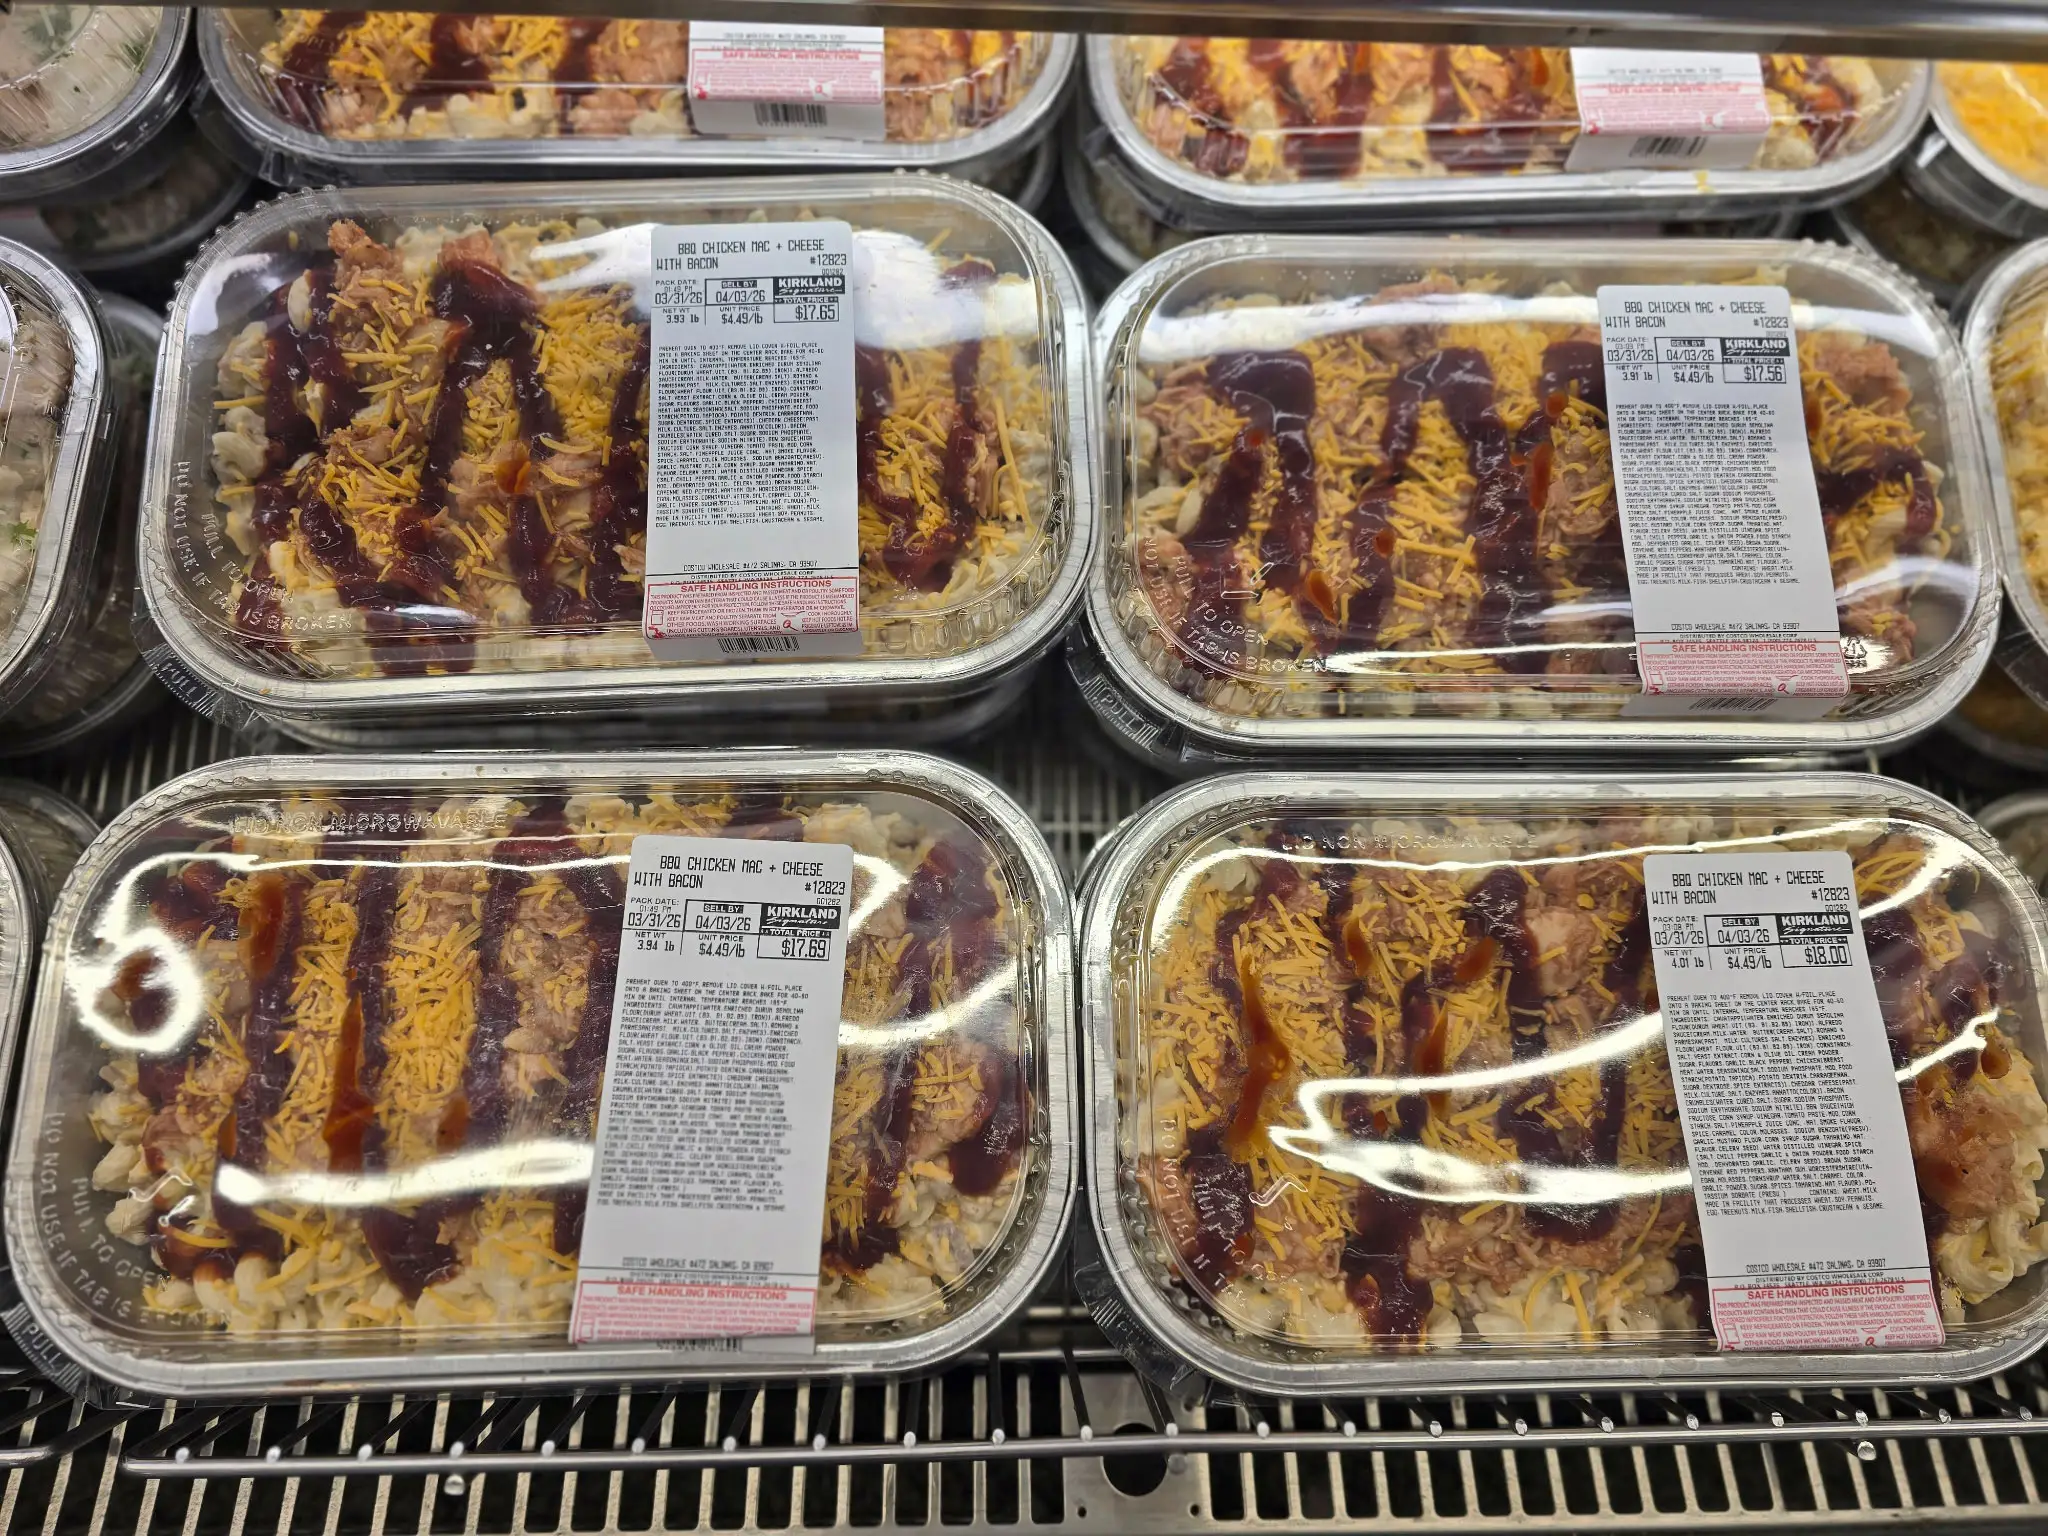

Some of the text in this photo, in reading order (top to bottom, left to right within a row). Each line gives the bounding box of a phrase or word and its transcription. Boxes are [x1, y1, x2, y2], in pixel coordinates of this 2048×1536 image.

[678, 243, 697, 255] BBQ
[702, 241, 746, 253] CHICKEN
[752, 241, 770, 252] MAC
[788, 239, 824, 251] CHEESE
[656, 257, 719, 270] WITH BACON
[810, 254, 847, 266] #12823
[778, 278, 842, 288] KIRKLAND
[655, 292, 702, 305] 03/31/26
[716, 290, 765, 303] 04/03/26
[795, 305, 836, 320] $17.65
[1625, 302, 1642, 313] BBQ
[1649, 302, 1691, 313] CHICKEN
[1696, 302, 1713, 313] MAC
[1731, 302, 1766, 313] CHEESE
[666, 315, 699, 323] 3.93 lb
[722, 314, 763, 324] $4.49/lb
[1605, 317, 1665, 328] WITH BACON
[1725, 339, 1786, 349] KIRKLAND
[1607, 350, 1654, 362] 03/31/26
[1667, 349, 1715, 361] 04/03/26
[1622, 372, 1652, 380] 3.91 lb
[1674, 373, 1714, 383] $4.49/lb
[1745, 366, 1783, 382] $17.56
[709, 583, 758, 591] HANDLING
[761, 580, 832, 589] INSTRUCTIONS
[1749, 644, 1817, 652] INSTRUCTIONS
[660, 855, 681, 870] BBQ
[688, 856, 736, 872] CHICKEN
[742, 860, 763, 874] MAC
[783, 862, 823, 876] CHEESE
[634, 872, 703, 888] WITH BACON
[1672, 874, 1691, 887] BBQ
[1698, 873, 1743, 886] CHICKEN
[1749, 872, 1768, 885] MAC
[1787, 870, 1825, 884] CHEESE
[805, 880, 845, 895] #12823
[1812, 887, 1850, 901] #12823
[1652, 890, 1716, 904] WITH BACON
[767, 906, 837, 919] KIRKLAND
[628, 913, 681, 928] 03/31/26
[695, 915, 751, 931] 04/03/26
[766, 917, 828, 926] Signature
[1781, 915, 1848, 926] KIRKLAND
[1784, 926, 1850, 934] Signature
[1655, 931, 1704, 945] 03/31/26
[1718, 930, 1770, 944] 04/03/26
[637, 940, 674, 951] 3.94 lb
[699, 943, 745, 957] $4.49/lb
[782, 939, 826, 957] $17.69
[1727, 956, 1772, 969] $4.49/lb
[1805, 947, 1847, 965] $18.00
[1672, 958, 1704, 968] 4.01 lb
[1746, 1264, 1769, 1273] COSTCO
[1772, 1263, 1805, 1272] WHOLESALE
[1857, 1260, 1865, 1268] CA
[1868, 1259, 1886, 1267] 93907
[617, 1286, 787, 1300] SAFE HANDLING INSTRUCTIONS
[1748, 1285, 1905, 1300] SAFE HANDLING INSTRUCTIONS
